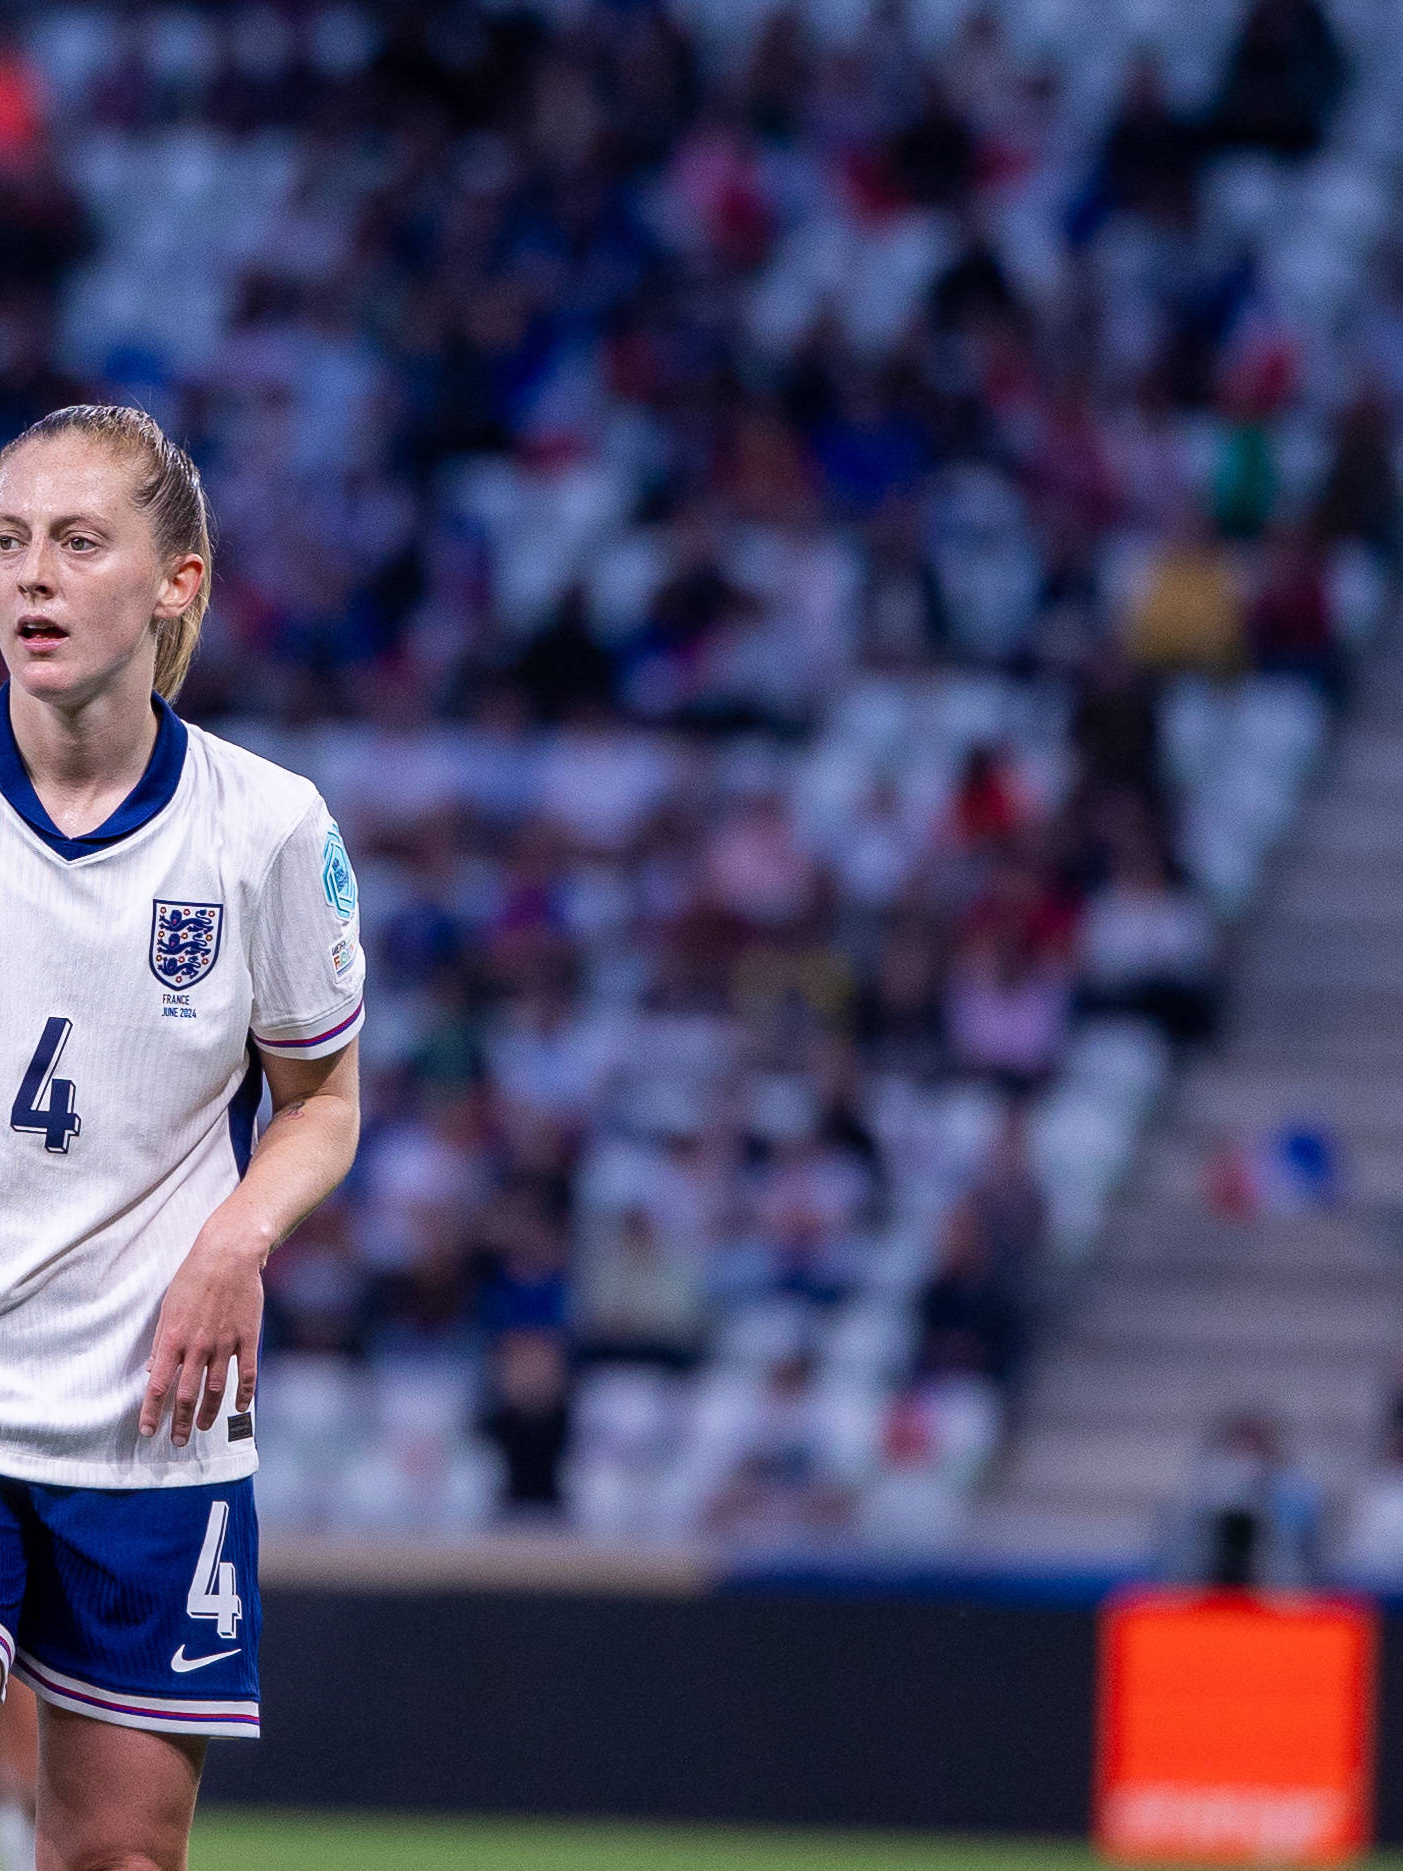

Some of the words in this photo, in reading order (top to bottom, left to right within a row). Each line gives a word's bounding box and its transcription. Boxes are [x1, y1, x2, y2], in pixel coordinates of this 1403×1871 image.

[161, 1007, 179, 1018] JUNE
[179, 1007, 197, 1019] 2024
[162, 993, 190, 1006] FRANCE
[10, 1016, 82, 1154] 4
[186, 1500, 242, 1639] 4
